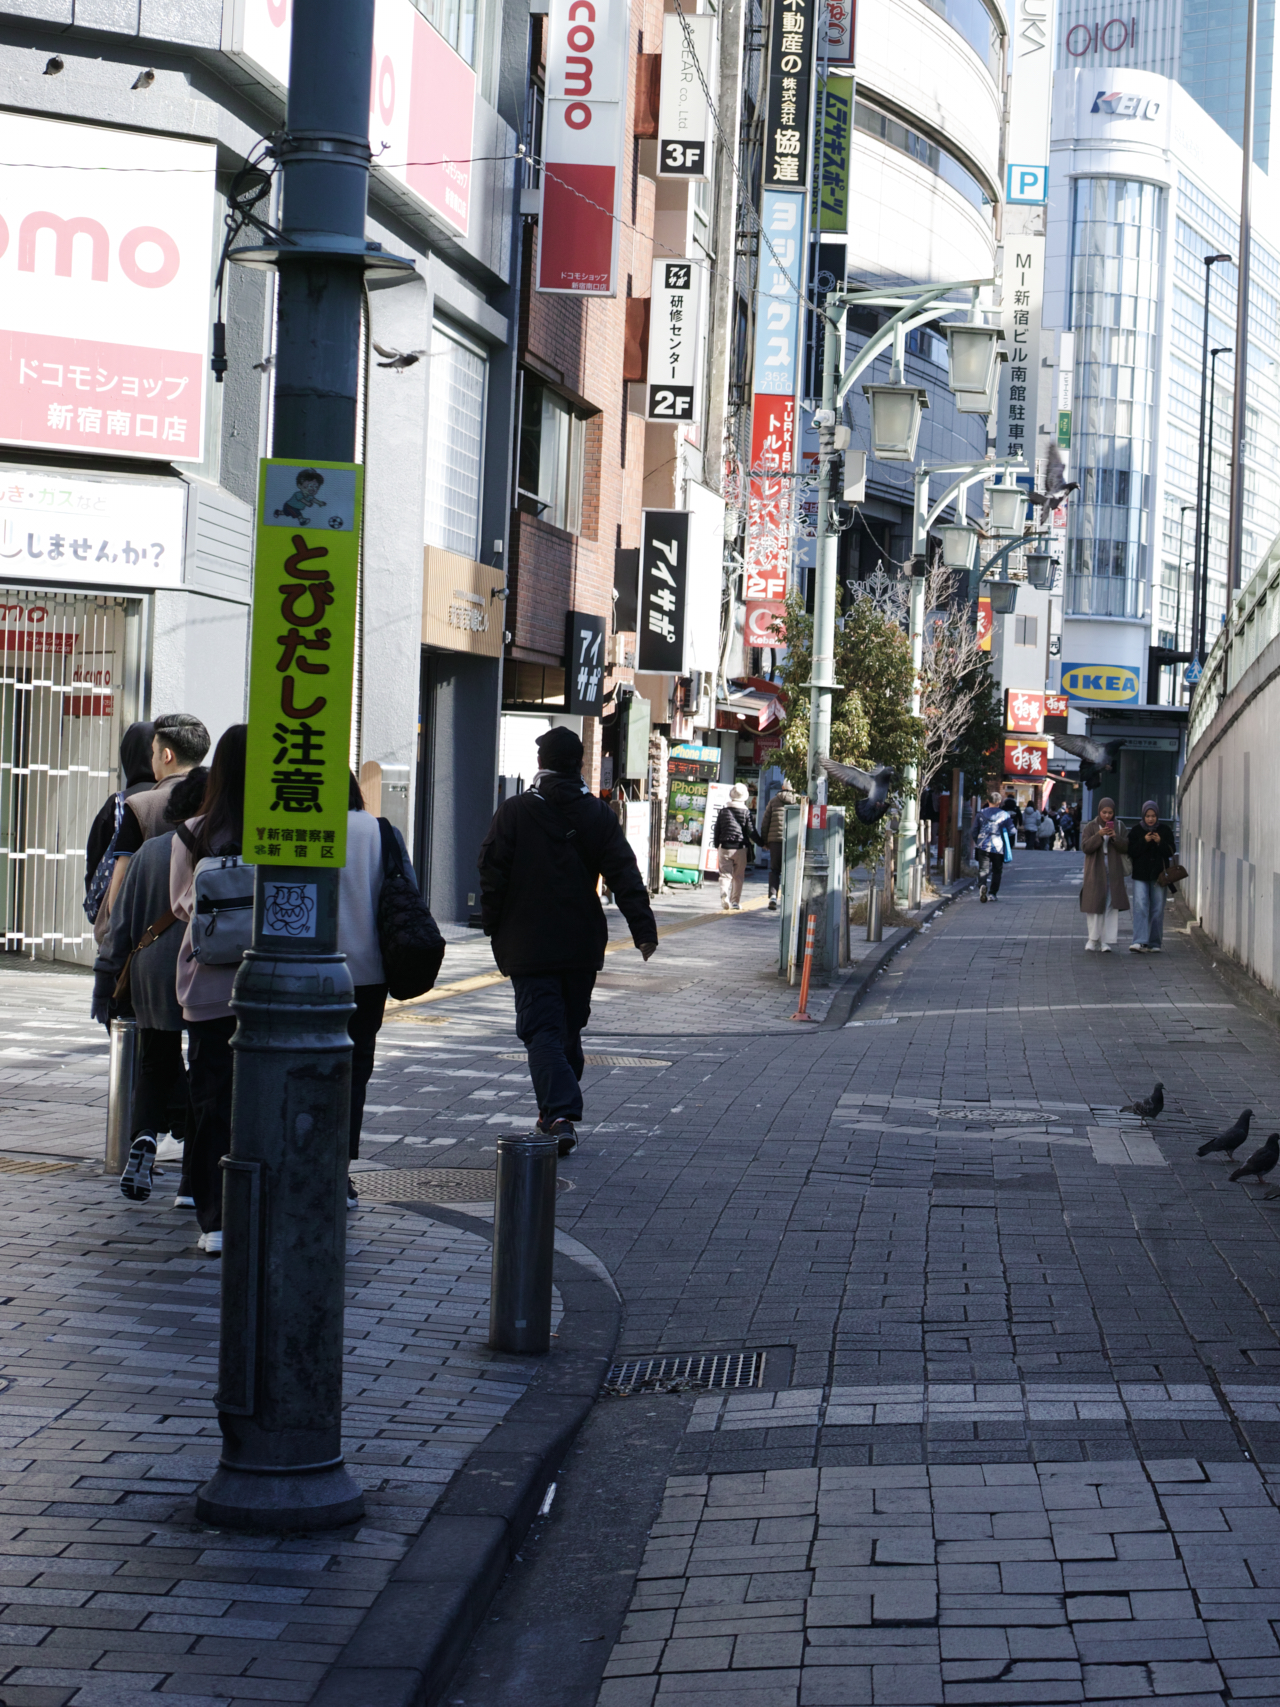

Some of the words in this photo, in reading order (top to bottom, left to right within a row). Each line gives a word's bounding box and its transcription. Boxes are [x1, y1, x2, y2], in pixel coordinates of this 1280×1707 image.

[781, 77, 798, 126] 株式会社
[1090, 91, 1161, 121] KEIO
[665, 143, 701, 167] 3F
[773, 128, 801, 182] 協達
[821, 91, 849, 216] ムラサキスポーツ
[1018, 171, 1039, 195] P
[0, 210, 180, 289] mo
[560, 271, 609, 284] ドコモショップ
[764, 202, 797, 367] ヨシックス
[669, 294, 684, 379] 研修センター
[17, 357, 189, 401] ドコモショップ
[765, 371, 788, 382] 352
[653, 390, 690, 416] 2F
[47, 403, 188, 443] 新宿南口店
[781, 402, 794, 471] TURKISH
[648, 539, 678, 643] アイサポ
[748, 579, 785, 598] 2F
[270, 534, 334, 813] とびだし注意
[1069, 674, 1136, 692] IKEA
[1012, 693, 1040, 721] すき家
[1046, 697, 1067, 710] すき家
[672, 745, 700, 760] iPhone
[1011, 741, 1042, 774] すき家
[671, 781, 708, 796] iPhone
[674, 794, 707, 812] 修理
[267, 828, 335, 843] 新宿警察署
